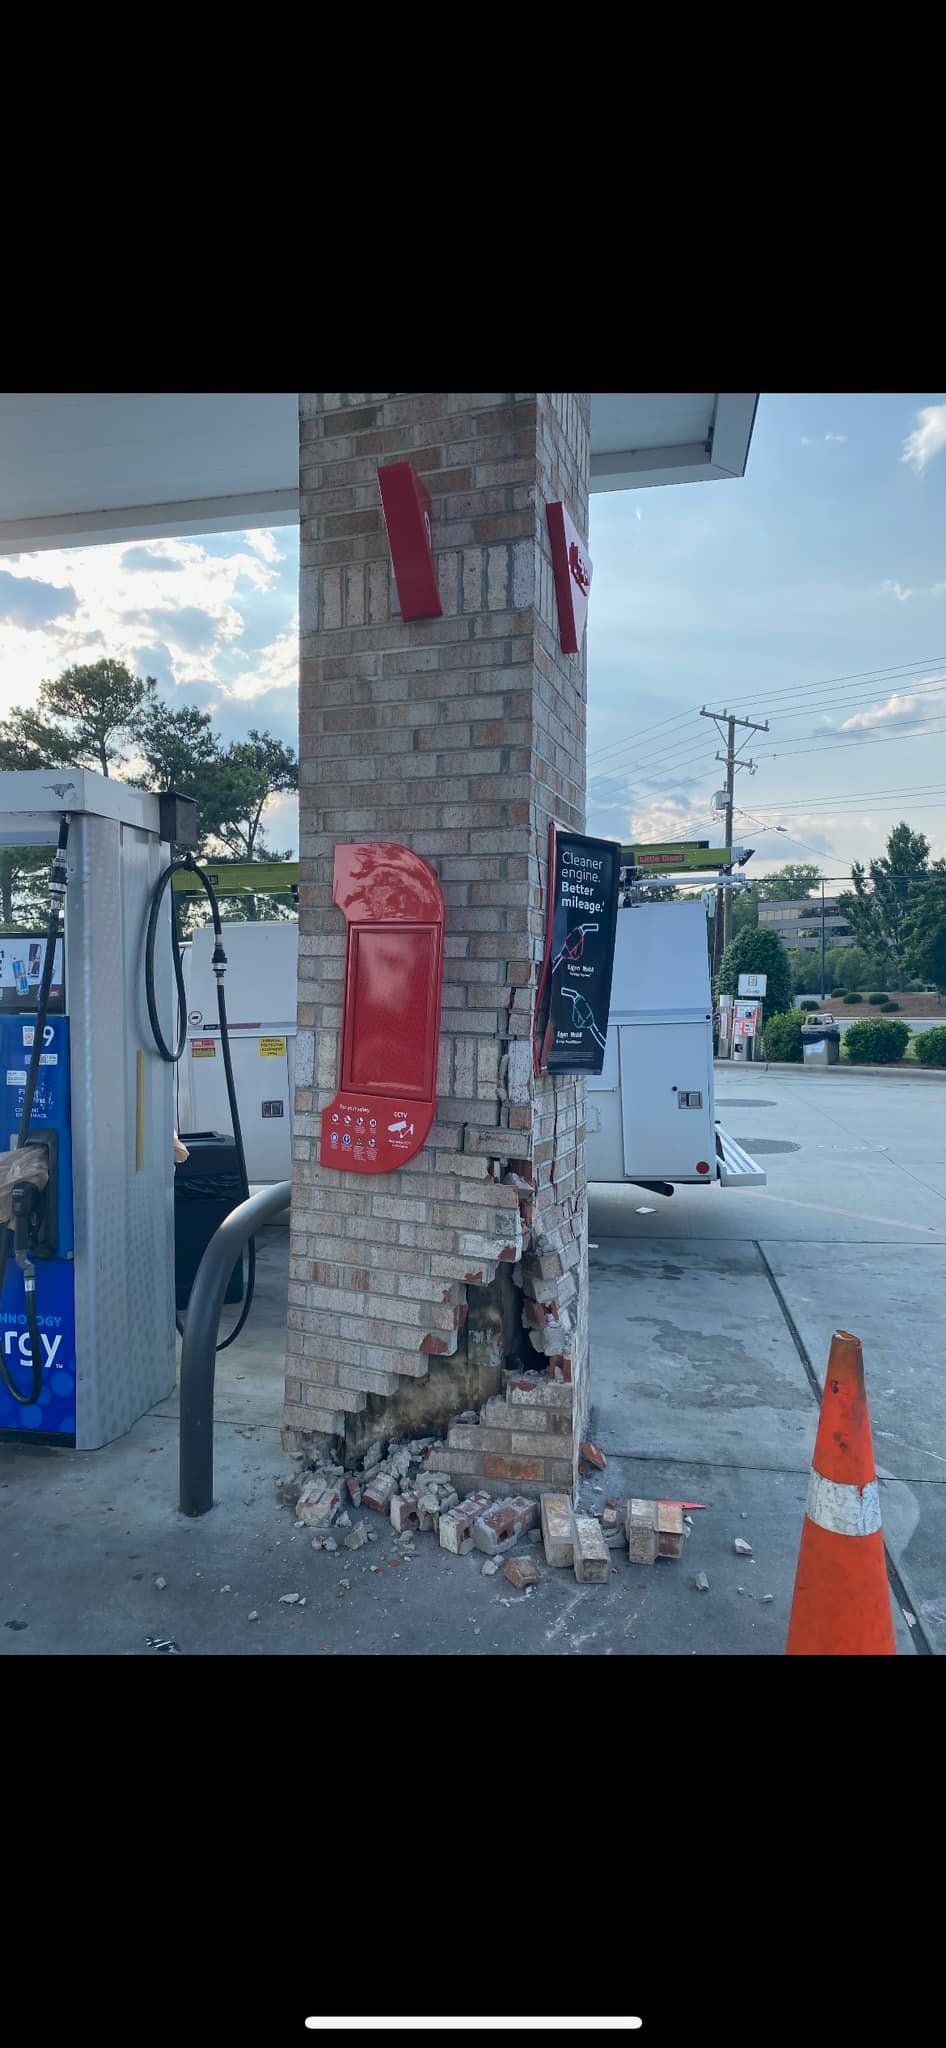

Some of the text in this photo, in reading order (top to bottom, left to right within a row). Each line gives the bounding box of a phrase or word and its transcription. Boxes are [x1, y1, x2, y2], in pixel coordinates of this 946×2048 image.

[562, 851, 603, 870] Cleaner
[561, 868, 601, 883] engine.
[561, 881, 594, 896] Better
[43, 1026, 55, 1046] 9
[393, 1111, 408, 1119] CCTV
[0, 1313, 61, 1327] HNOOGY
